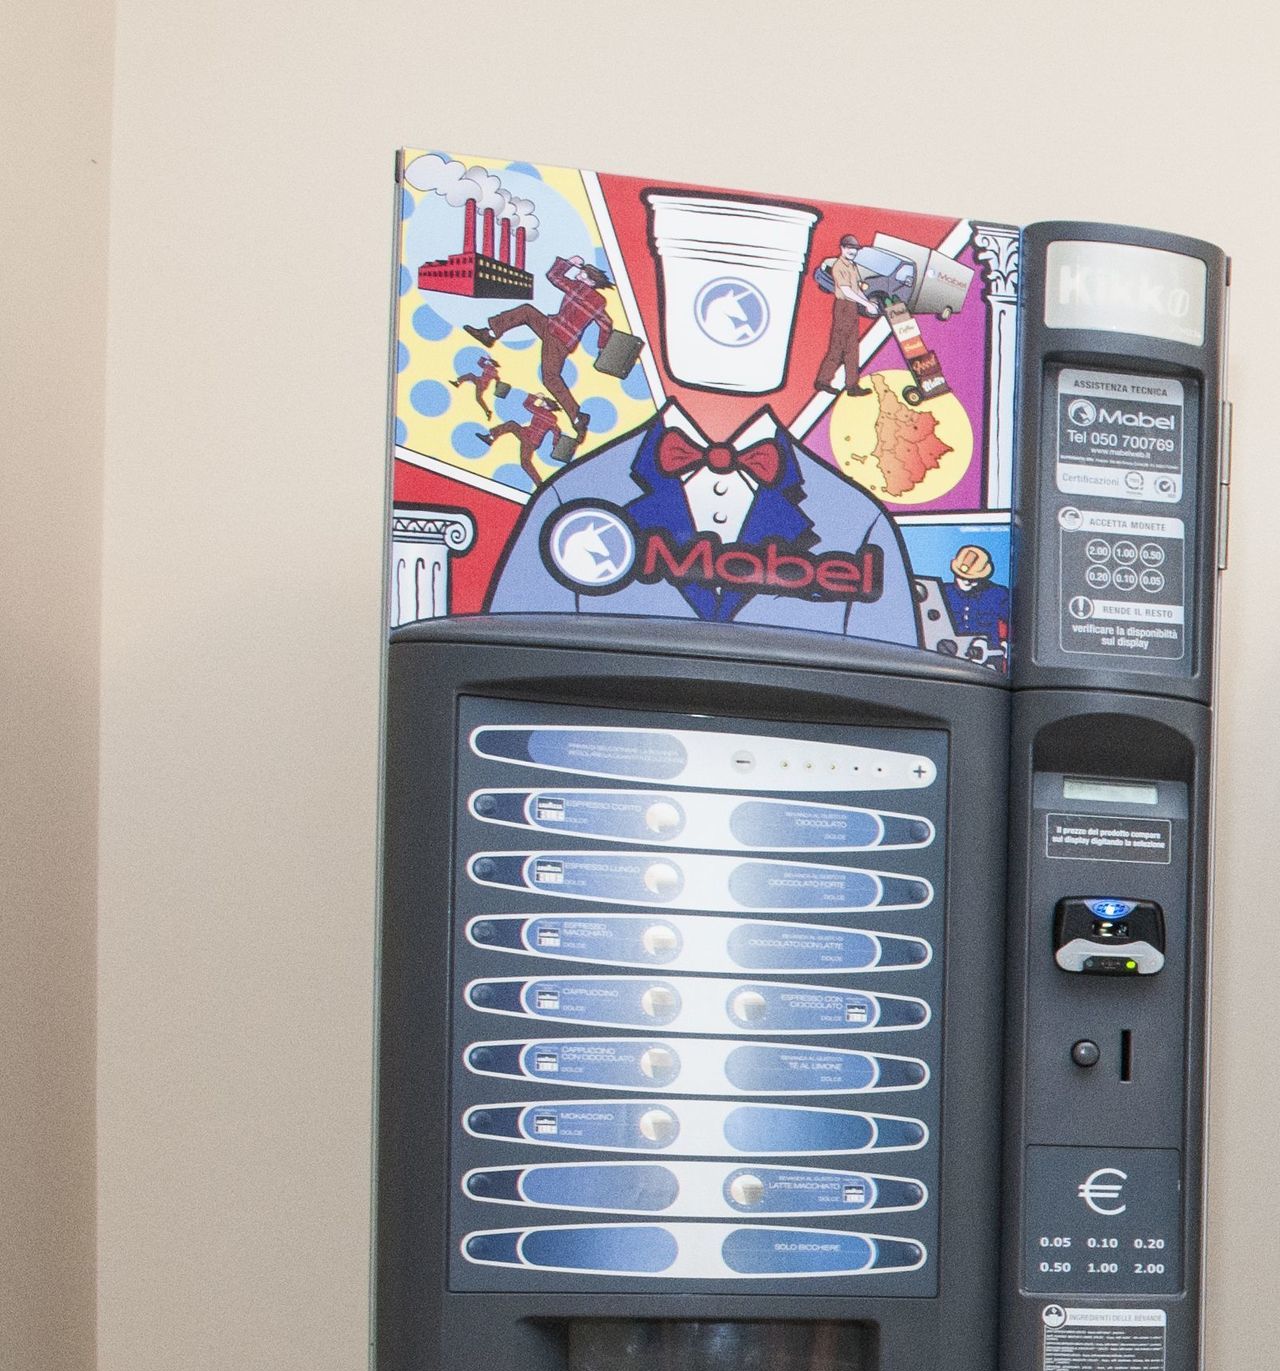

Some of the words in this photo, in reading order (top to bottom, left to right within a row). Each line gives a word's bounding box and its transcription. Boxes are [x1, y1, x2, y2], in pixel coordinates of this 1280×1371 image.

[1074, 380, 1128, 393] ASSISTENZA
[1131, 385, 1168, 397] TECNICA
[1099, 408, 1175, 430] Mabel
[1067, 429, 1087, 444] Tel
[1091, 432, 1118, 446] 050
[1121, 435, 1175, 452] 700769
[1062, 473, 1120, 487] Certificazioni
[1089, 518, 1128, 530] ACCETTA
[1130, 521, 1167, 533] MONETE
[1089, 545, 1109, 557] 2.00
[1116, 548, 1135, 558] 1.00
[1142, 551, 1162, 561] 0.50
[642, 533, 874, 594] Mabel
[1088, 571, 1109, 582] 0.20
[1116, 573, 1135, 584] 0.10
[1142, 576, 1162, 586] 0.05
[1102, 605, 1132, 616] RENDE
[1144, 608, 1174, 619] RESTO
[1117, 637, 1150, 650] display
[1077, 1167, 1128, 1216] €
[1039, 1236, 1072, 1248] 0.05
[1087, 1237, 1118, 1249] 0.10
[1133, 1238, 1165, 1249] 0.20
[1039, 1261, 1072, 1273] 0.50
[1087, 1262, 1118, 1273] 1.00
[1133, 1263, 1165, 1274] 2.00
